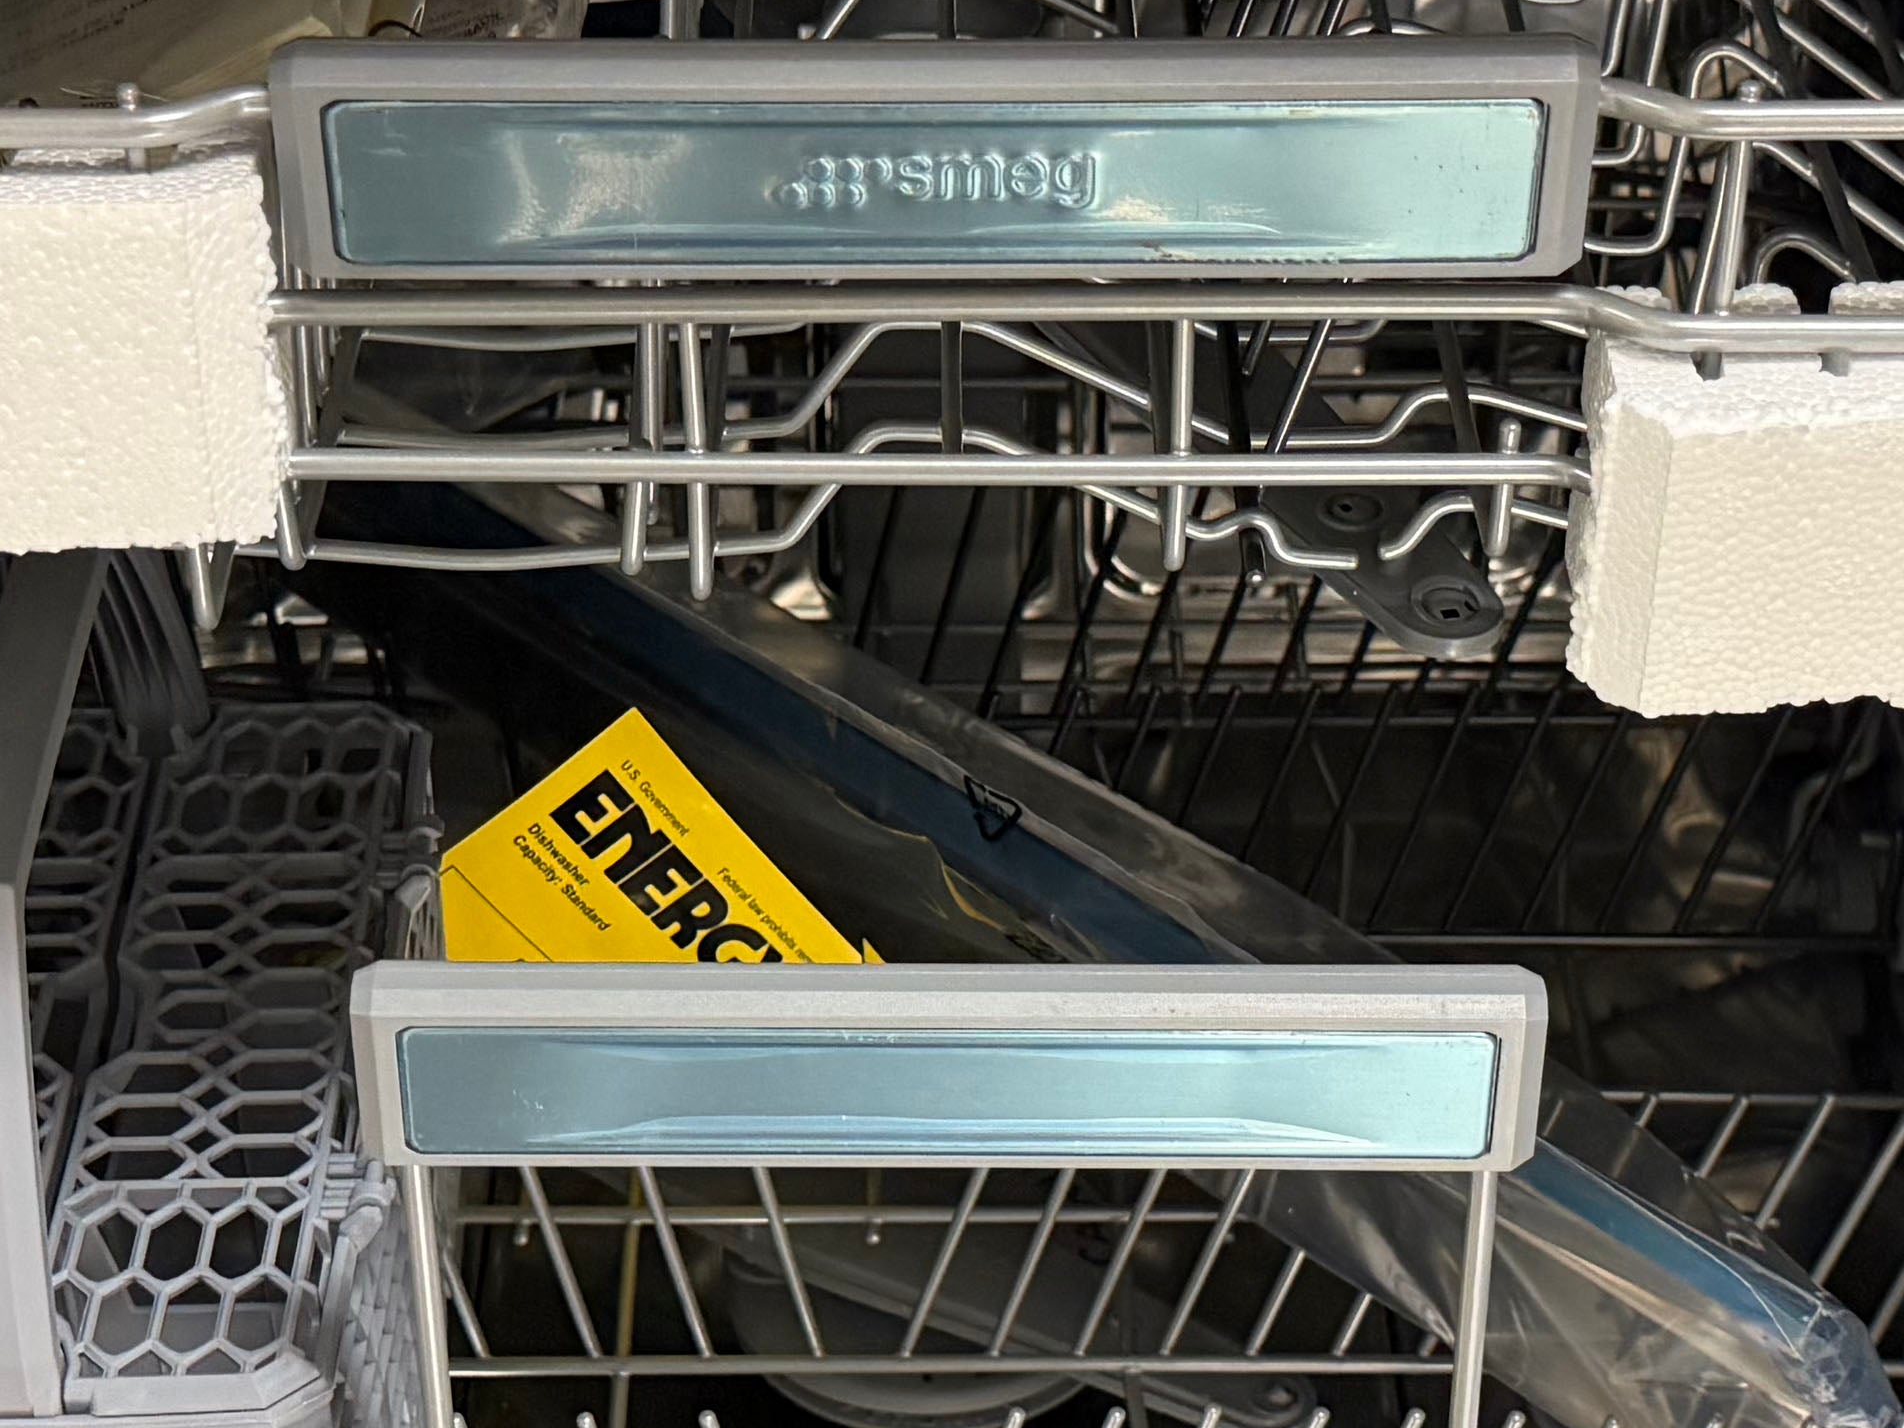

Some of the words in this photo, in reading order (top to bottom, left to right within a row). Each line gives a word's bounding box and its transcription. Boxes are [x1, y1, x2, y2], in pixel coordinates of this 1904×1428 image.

[898, 152, 1101, 210] smeg
[621, 759, 641, 782] U.S.
[639, 780, 690, 838] Government
[513, 835, 563, 887] Capacity:
[560, 883, 612, 932] Standard
[527, 822, 590, 887] Dishwasher
[549, 768, 783, 962] ENERG
[716, 867, 752, 902] Federal
[747, 897, 764, 916] law
[759, 912, 798, 950] prohibits
